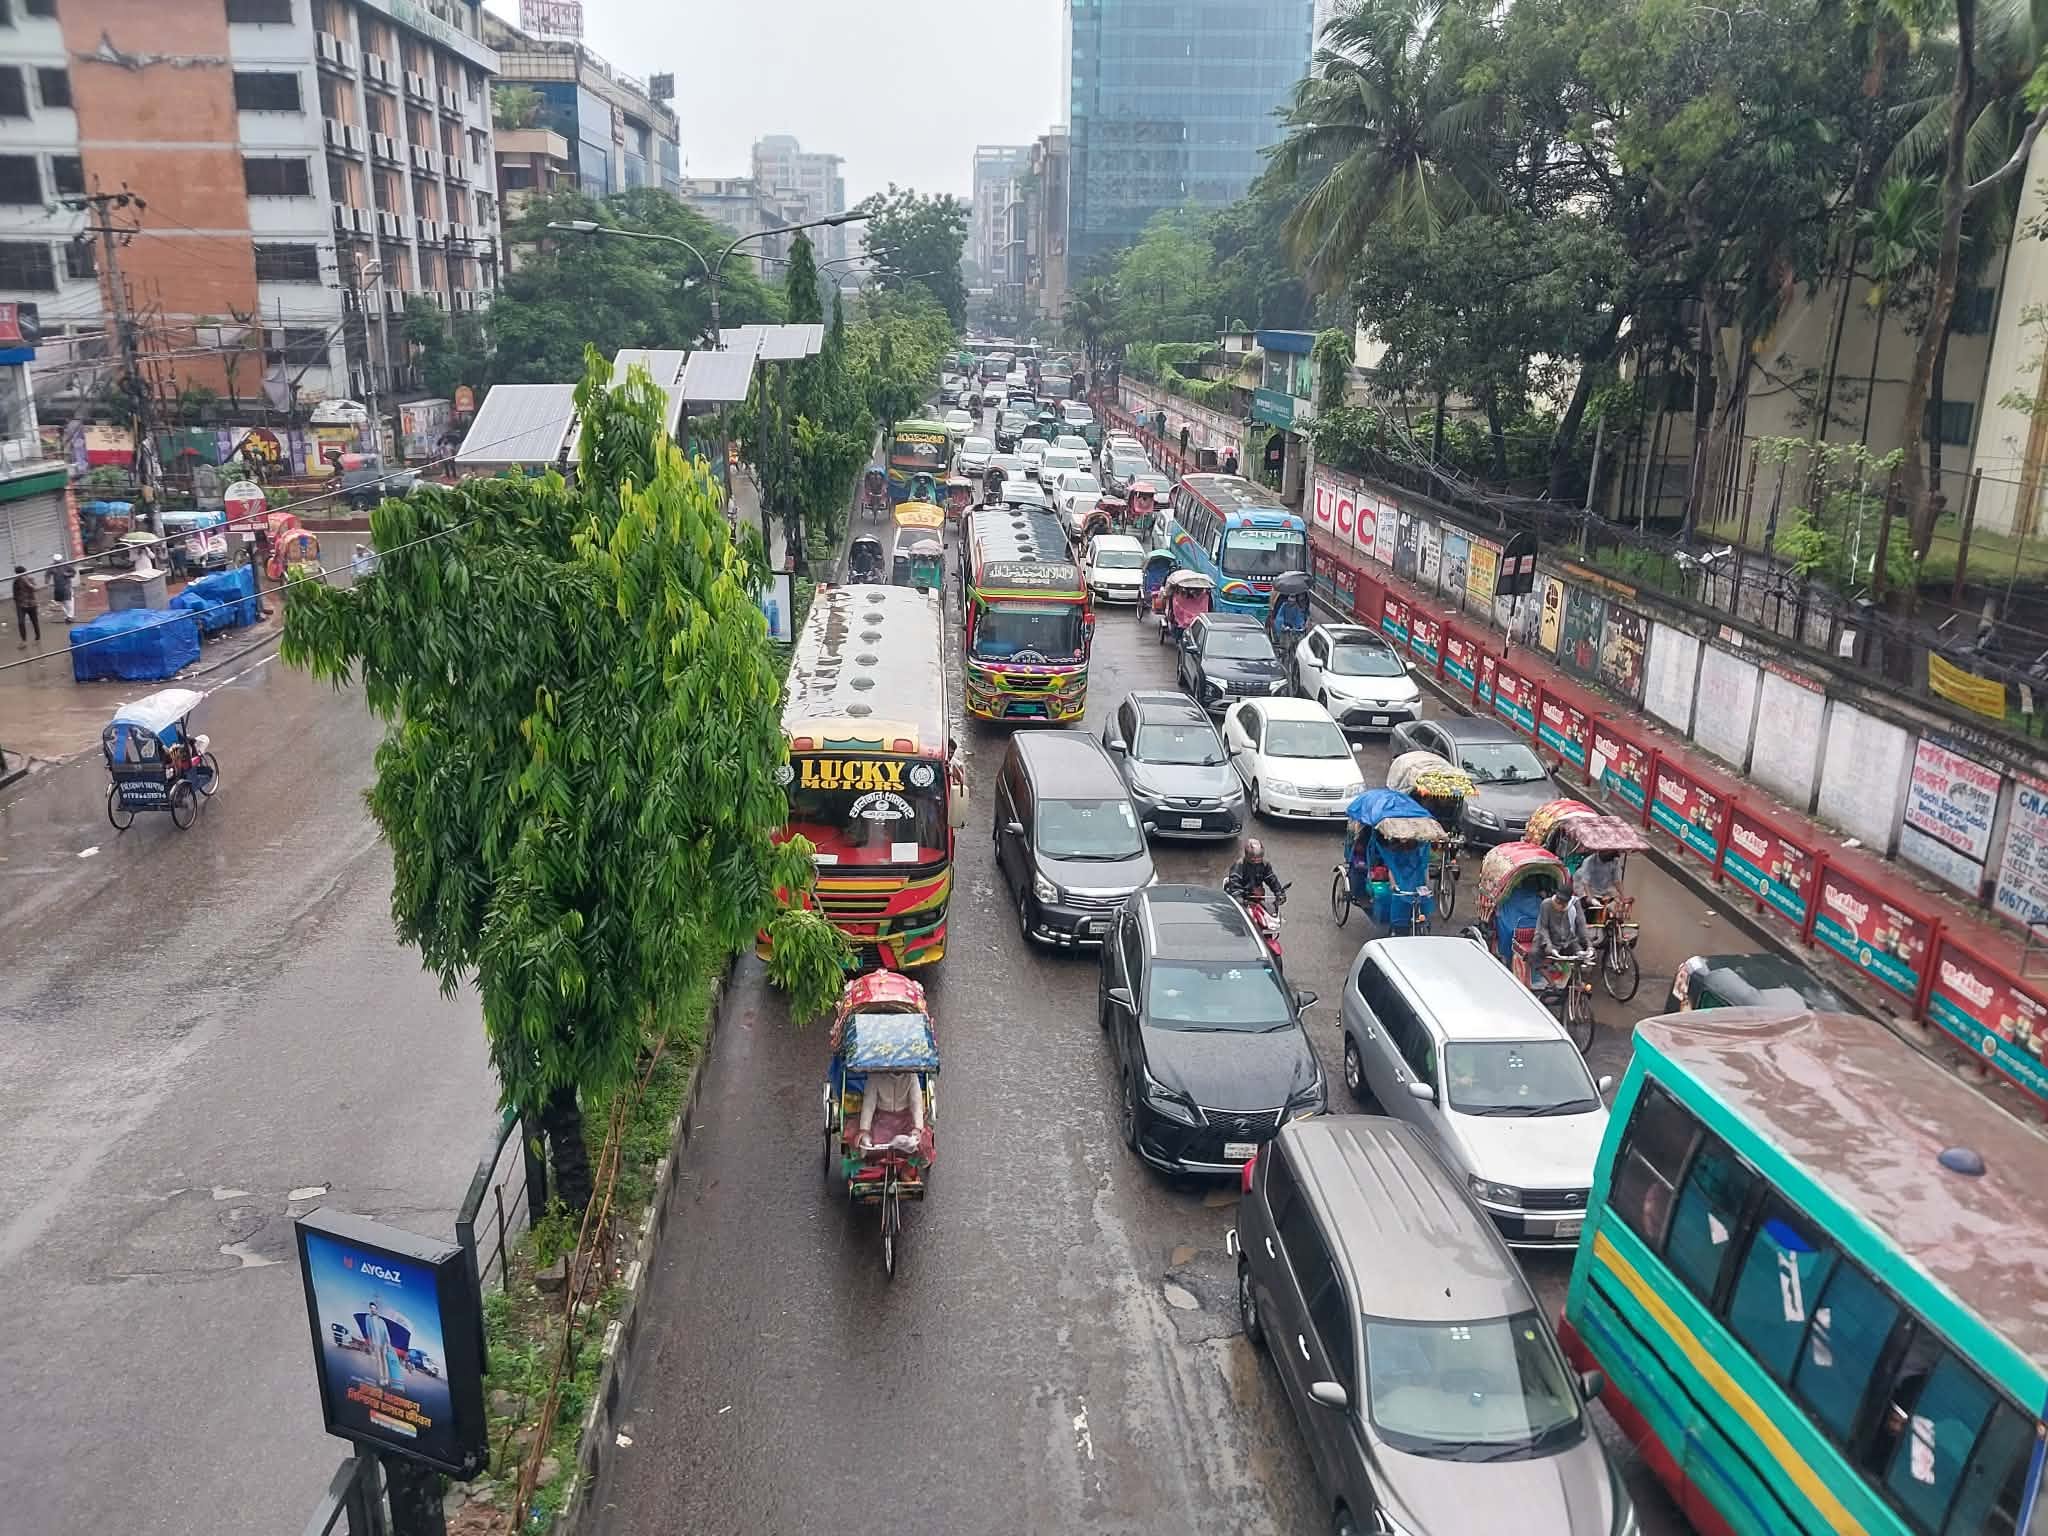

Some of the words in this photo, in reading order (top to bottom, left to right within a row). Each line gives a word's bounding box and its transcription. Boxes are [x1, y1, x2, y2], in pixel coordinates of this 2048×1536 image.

[1317, 487, 1376, 545] UCC
[801, 760, 905, 782] LUCKY
[801, 779, 904, 791] MOTORS
[361, 1261, 401, 1283] AYGAZ
